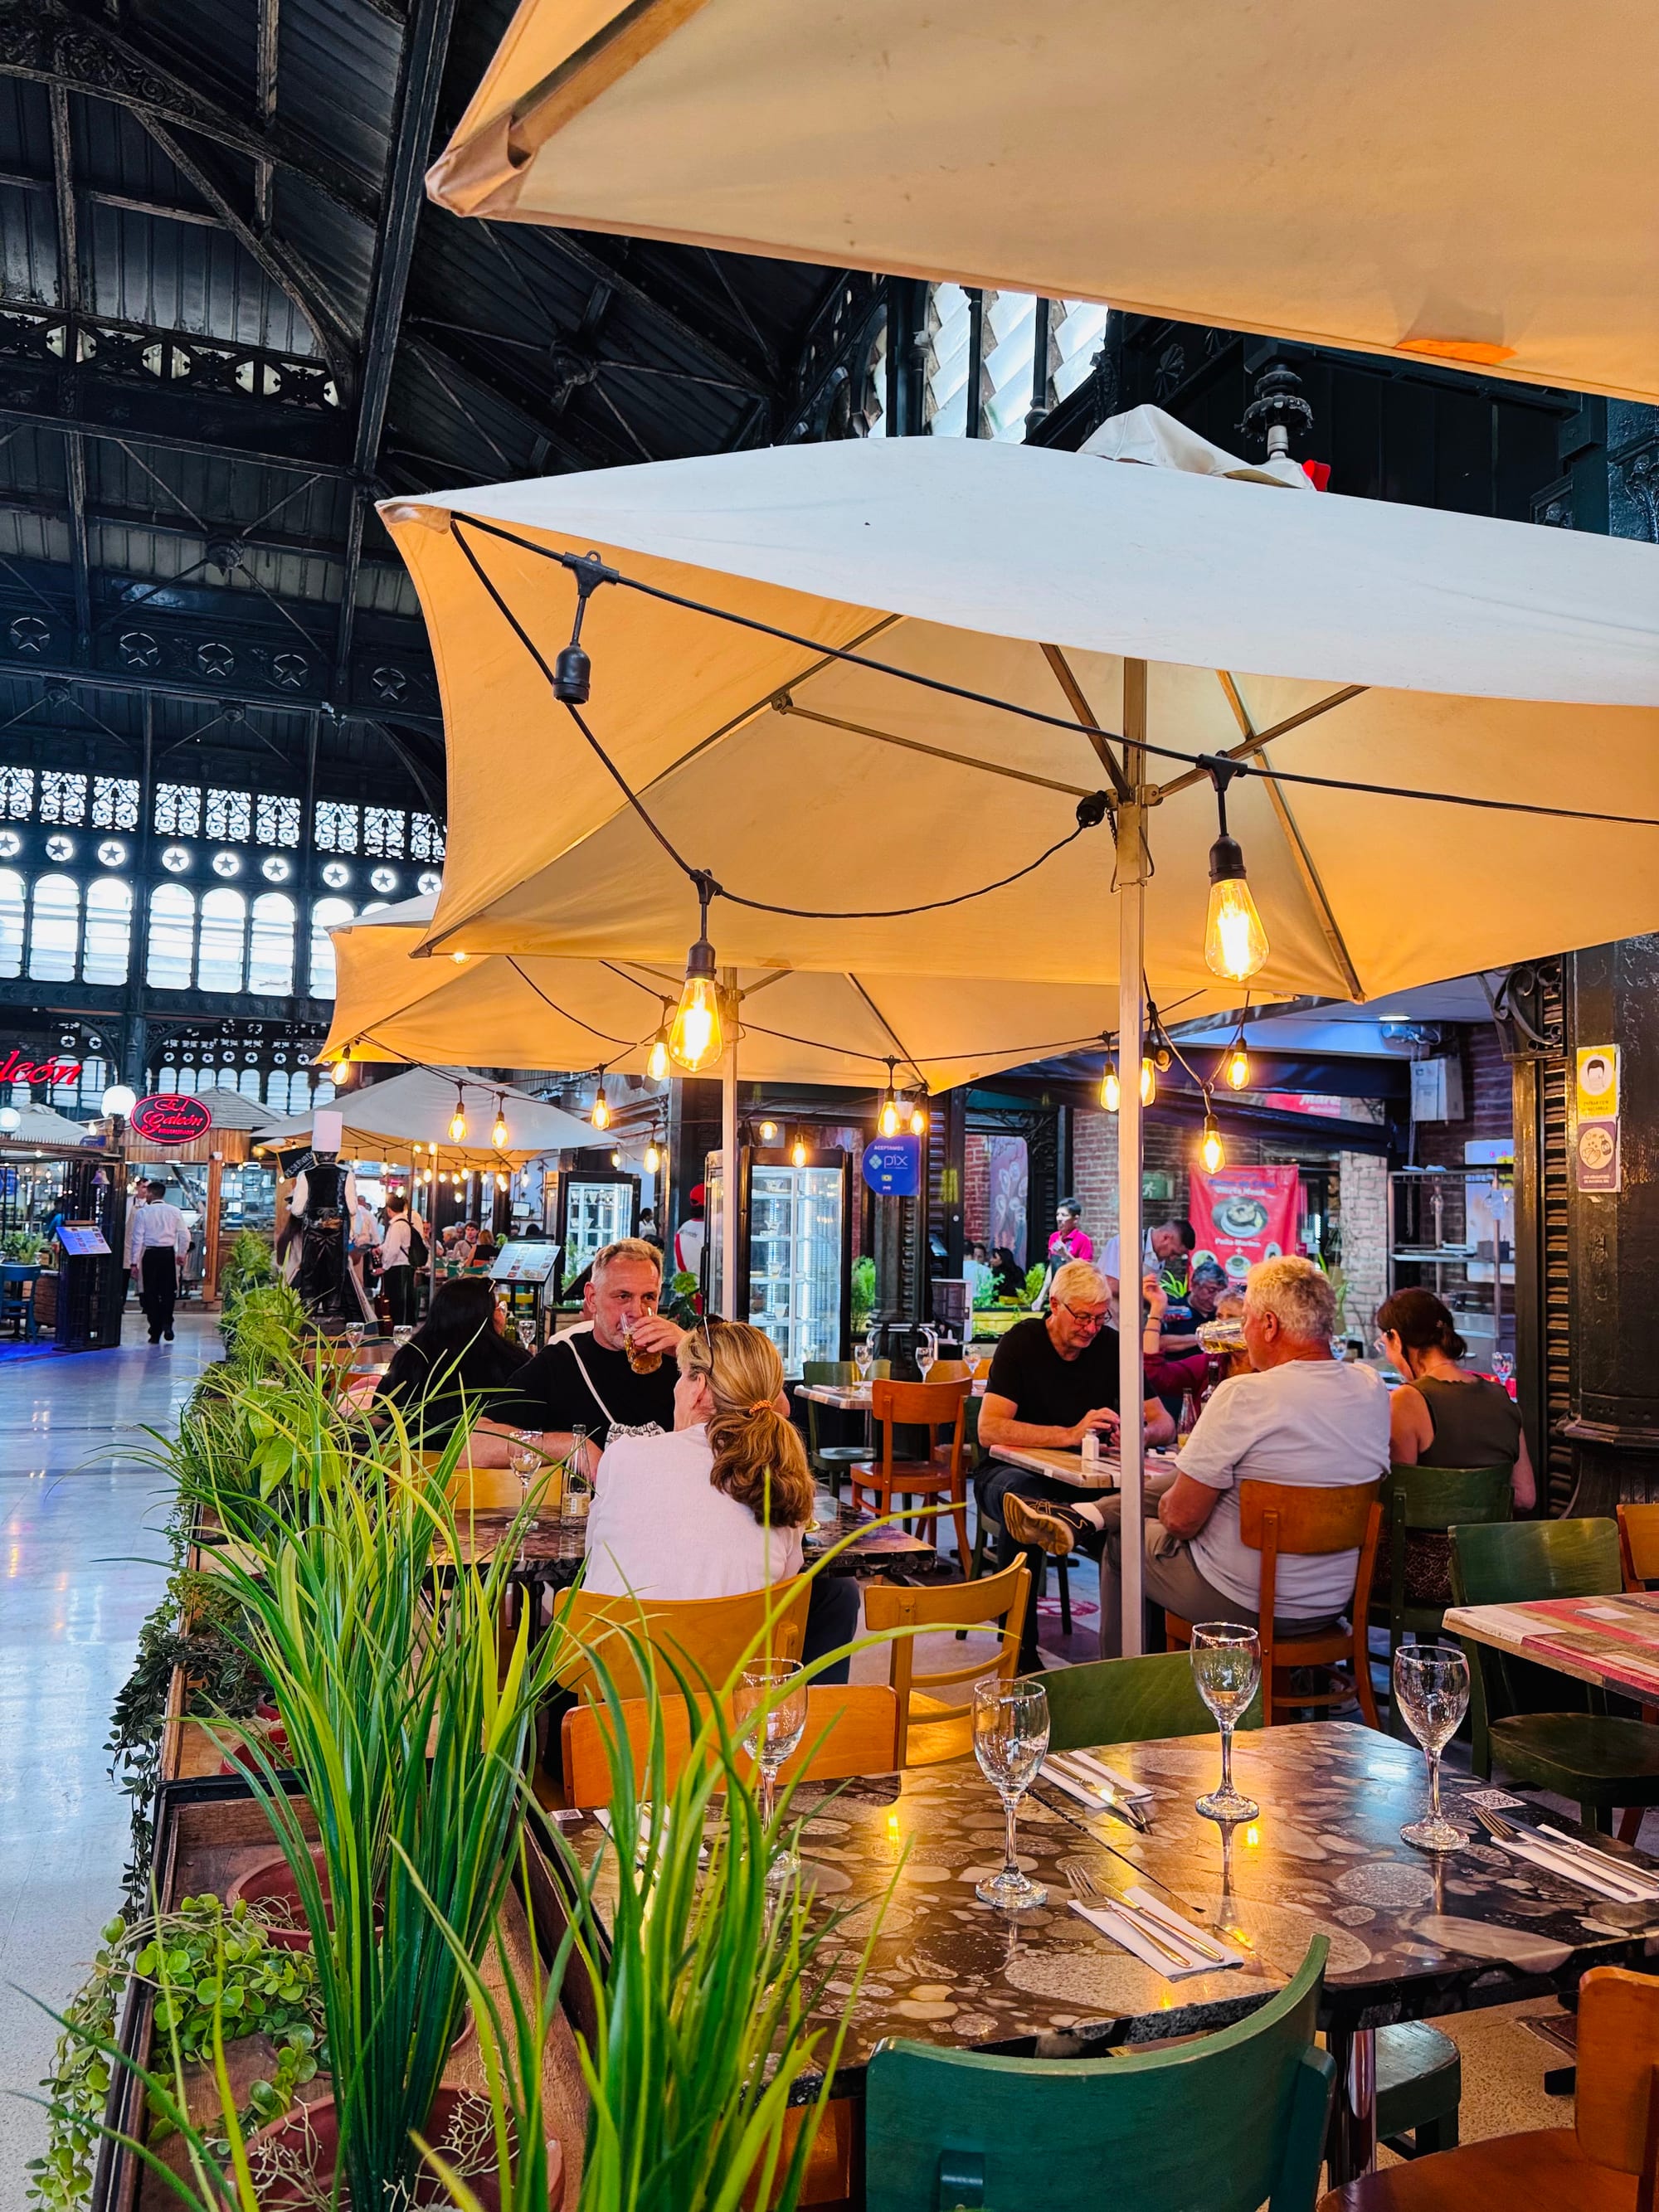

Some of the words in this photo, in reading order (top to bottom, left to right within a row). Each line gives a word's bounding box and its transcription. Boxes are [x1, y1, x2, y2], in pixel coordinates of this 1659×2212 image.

[0, 1050, 81, 1085] león
[154, 1098, 190, 1111] El
[883, 1155, 908, 1169] pix
